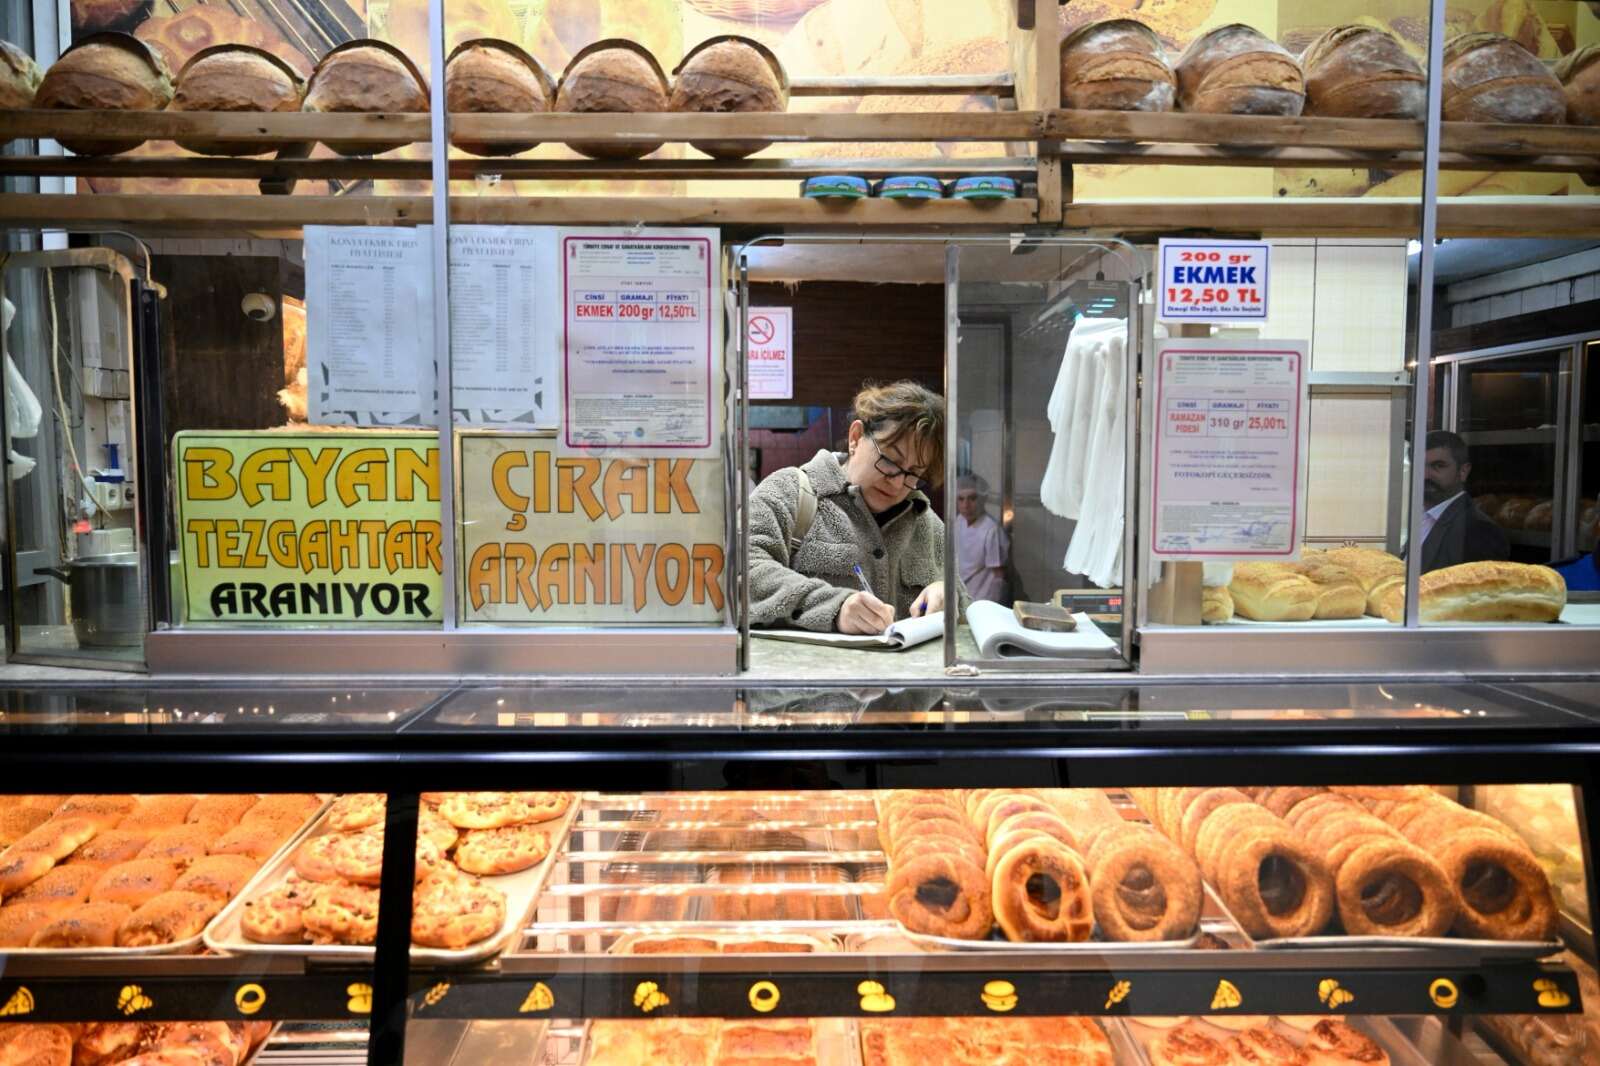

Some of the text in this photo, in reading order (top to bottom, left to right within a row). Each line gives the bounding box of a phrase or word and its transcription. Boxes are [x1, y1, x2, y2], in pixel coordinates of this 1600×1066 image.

[1173, 266, 1257, 284] EKMEK
[1180, 251, 1252, 265] 200 gr
[576, 304, 614, 317] EKMEK
[1167, 287, 1262, 305] 12,50 TL
[183, 446, 441, 508] BAYAN
[492, 450, 700, 532] ÇIRAK
[187, 519, 443, 576] TEZGAHTAR
[468, 541, 725, 614] ARANIYOR
[210, 581, 433, 619] ARANIYOR
